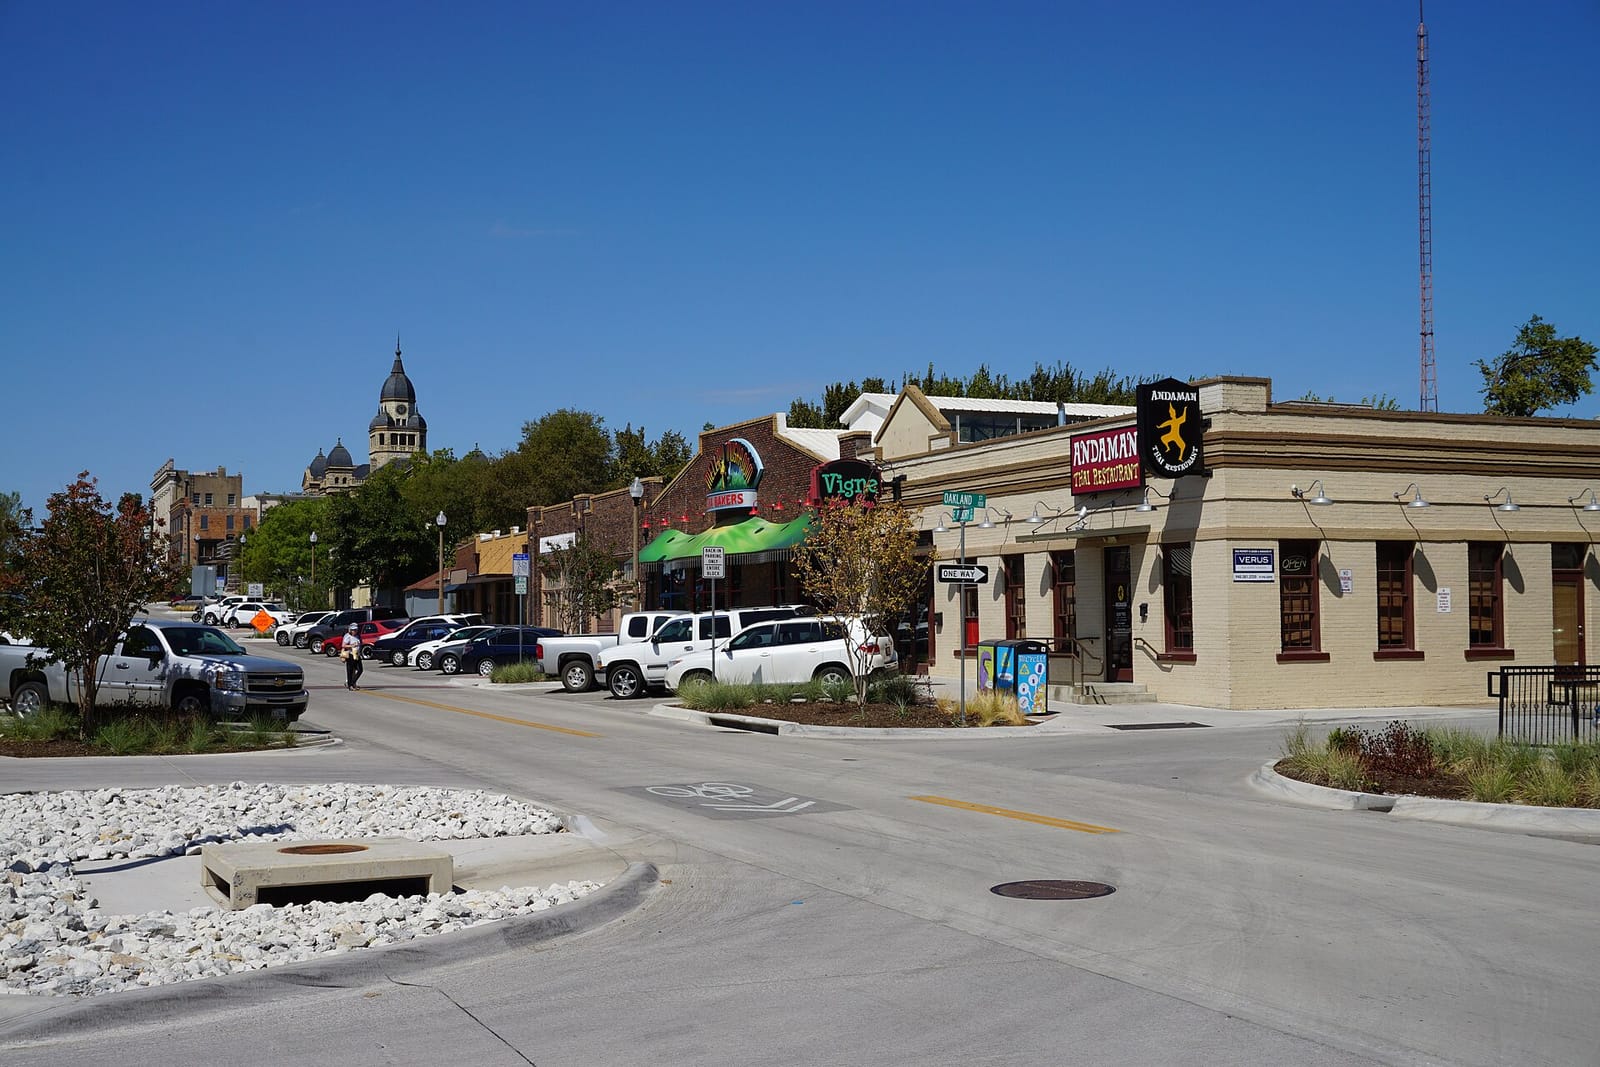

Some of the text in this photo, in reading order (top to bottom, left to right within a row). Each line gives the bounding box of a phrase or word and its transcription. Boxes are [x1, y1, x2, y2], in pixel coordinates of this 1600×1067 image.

[1151, 390, 1197, 402] ANDAMAN
[1073, 431, 1138, 467] ANDAMAN
[1151, 445, 1199, 472] THAI RESTAURANT
[1073, 463, 1139, 488] THAI RESTAURANT
[821, 473, 879, 498] Vigne
[944, 493, 973, 506] OAKLAND
[1238, 556, 1269, 564] VERUS
[1282, 558, 1307, 569] OPEN
[943, 570, 976, 578] ONE WAY
